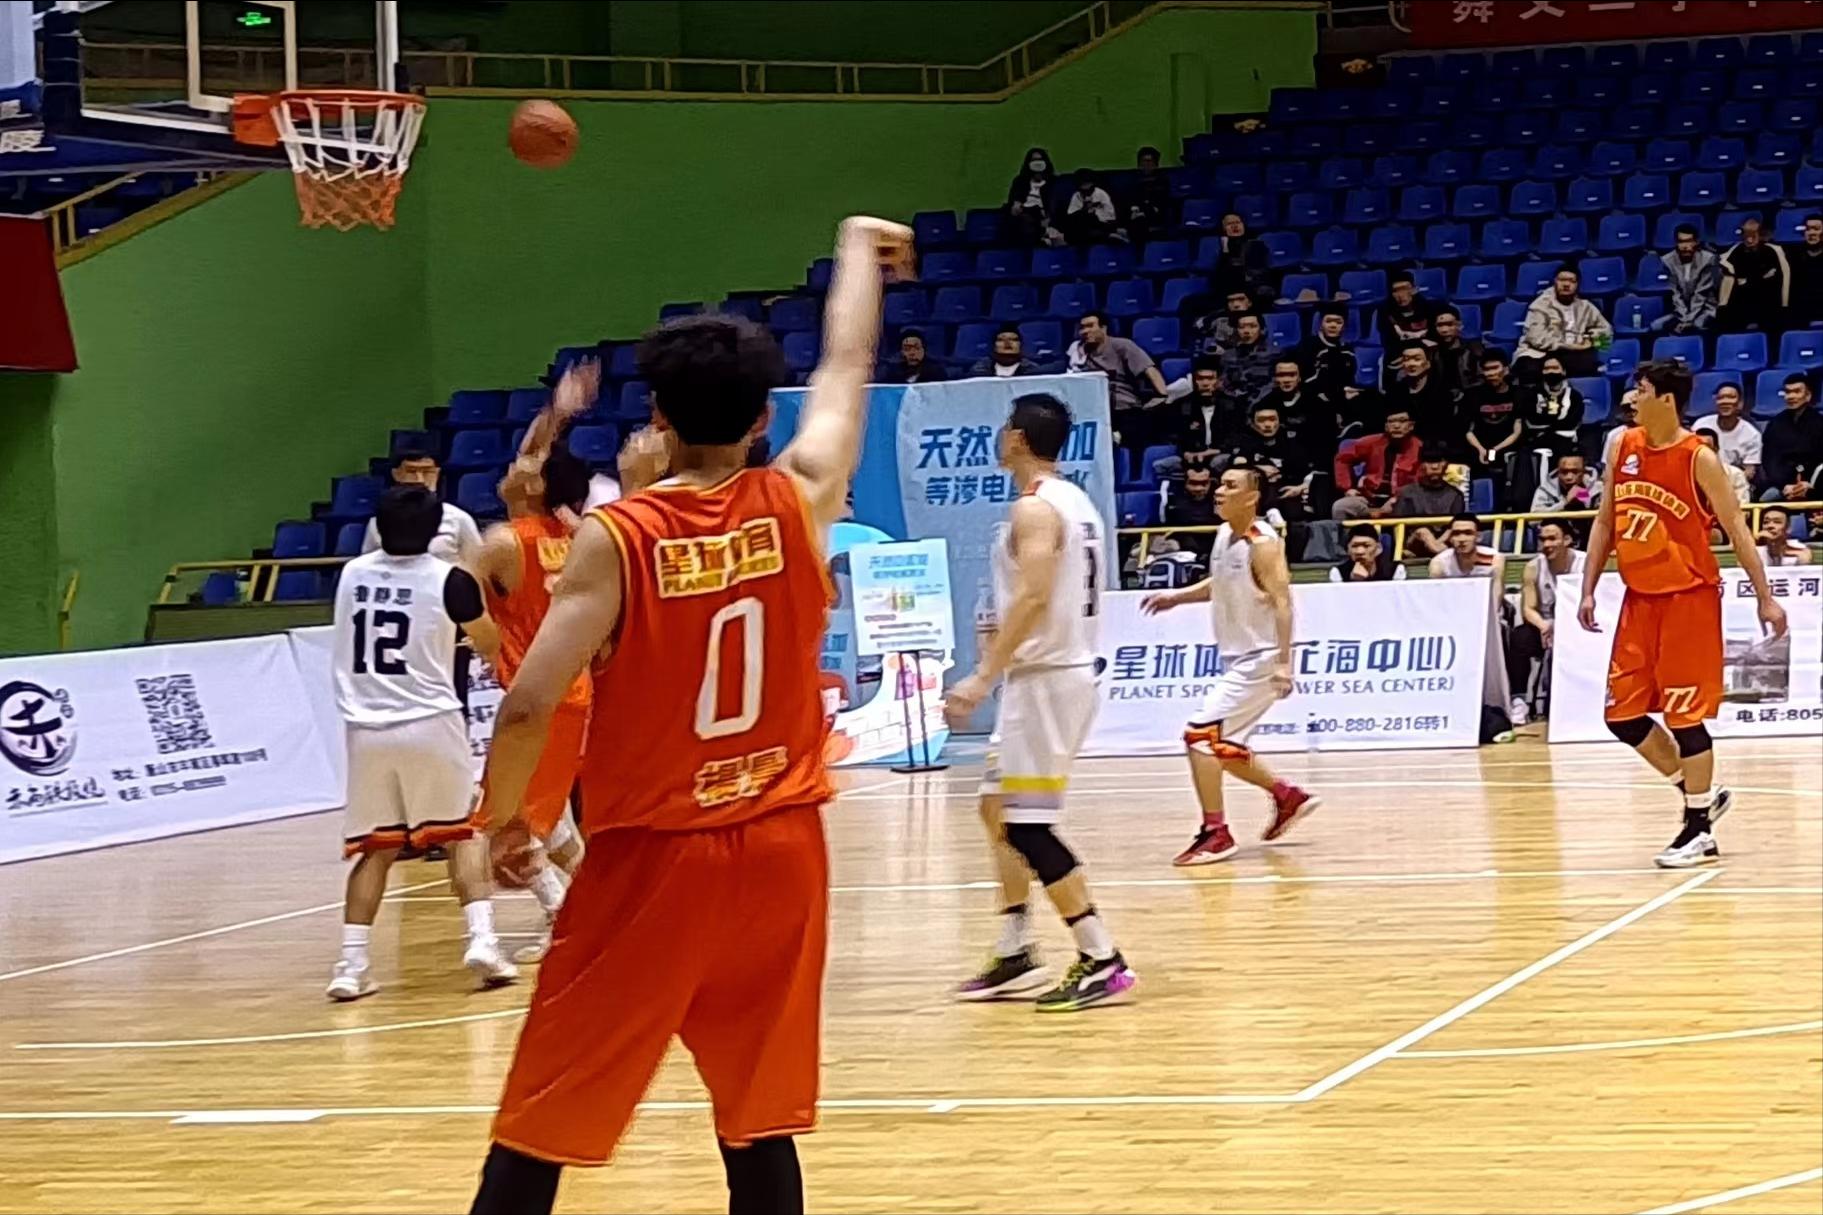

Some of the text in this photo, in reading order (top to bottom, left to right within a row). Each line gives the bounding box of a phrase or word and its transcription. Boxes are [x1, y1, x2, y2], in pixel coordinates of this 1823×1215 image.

[916, 421, 1098, 469] 天然加
[1622, 508, 1658, 542] 77
[352, 608, 411, 675] 12
[695, 597, 764, 740] 0
[1109, 684, 1177, 700] PLANET
[1342, 680, 1375, 694] SEA
[1663, 686, 1698, 714] 77
